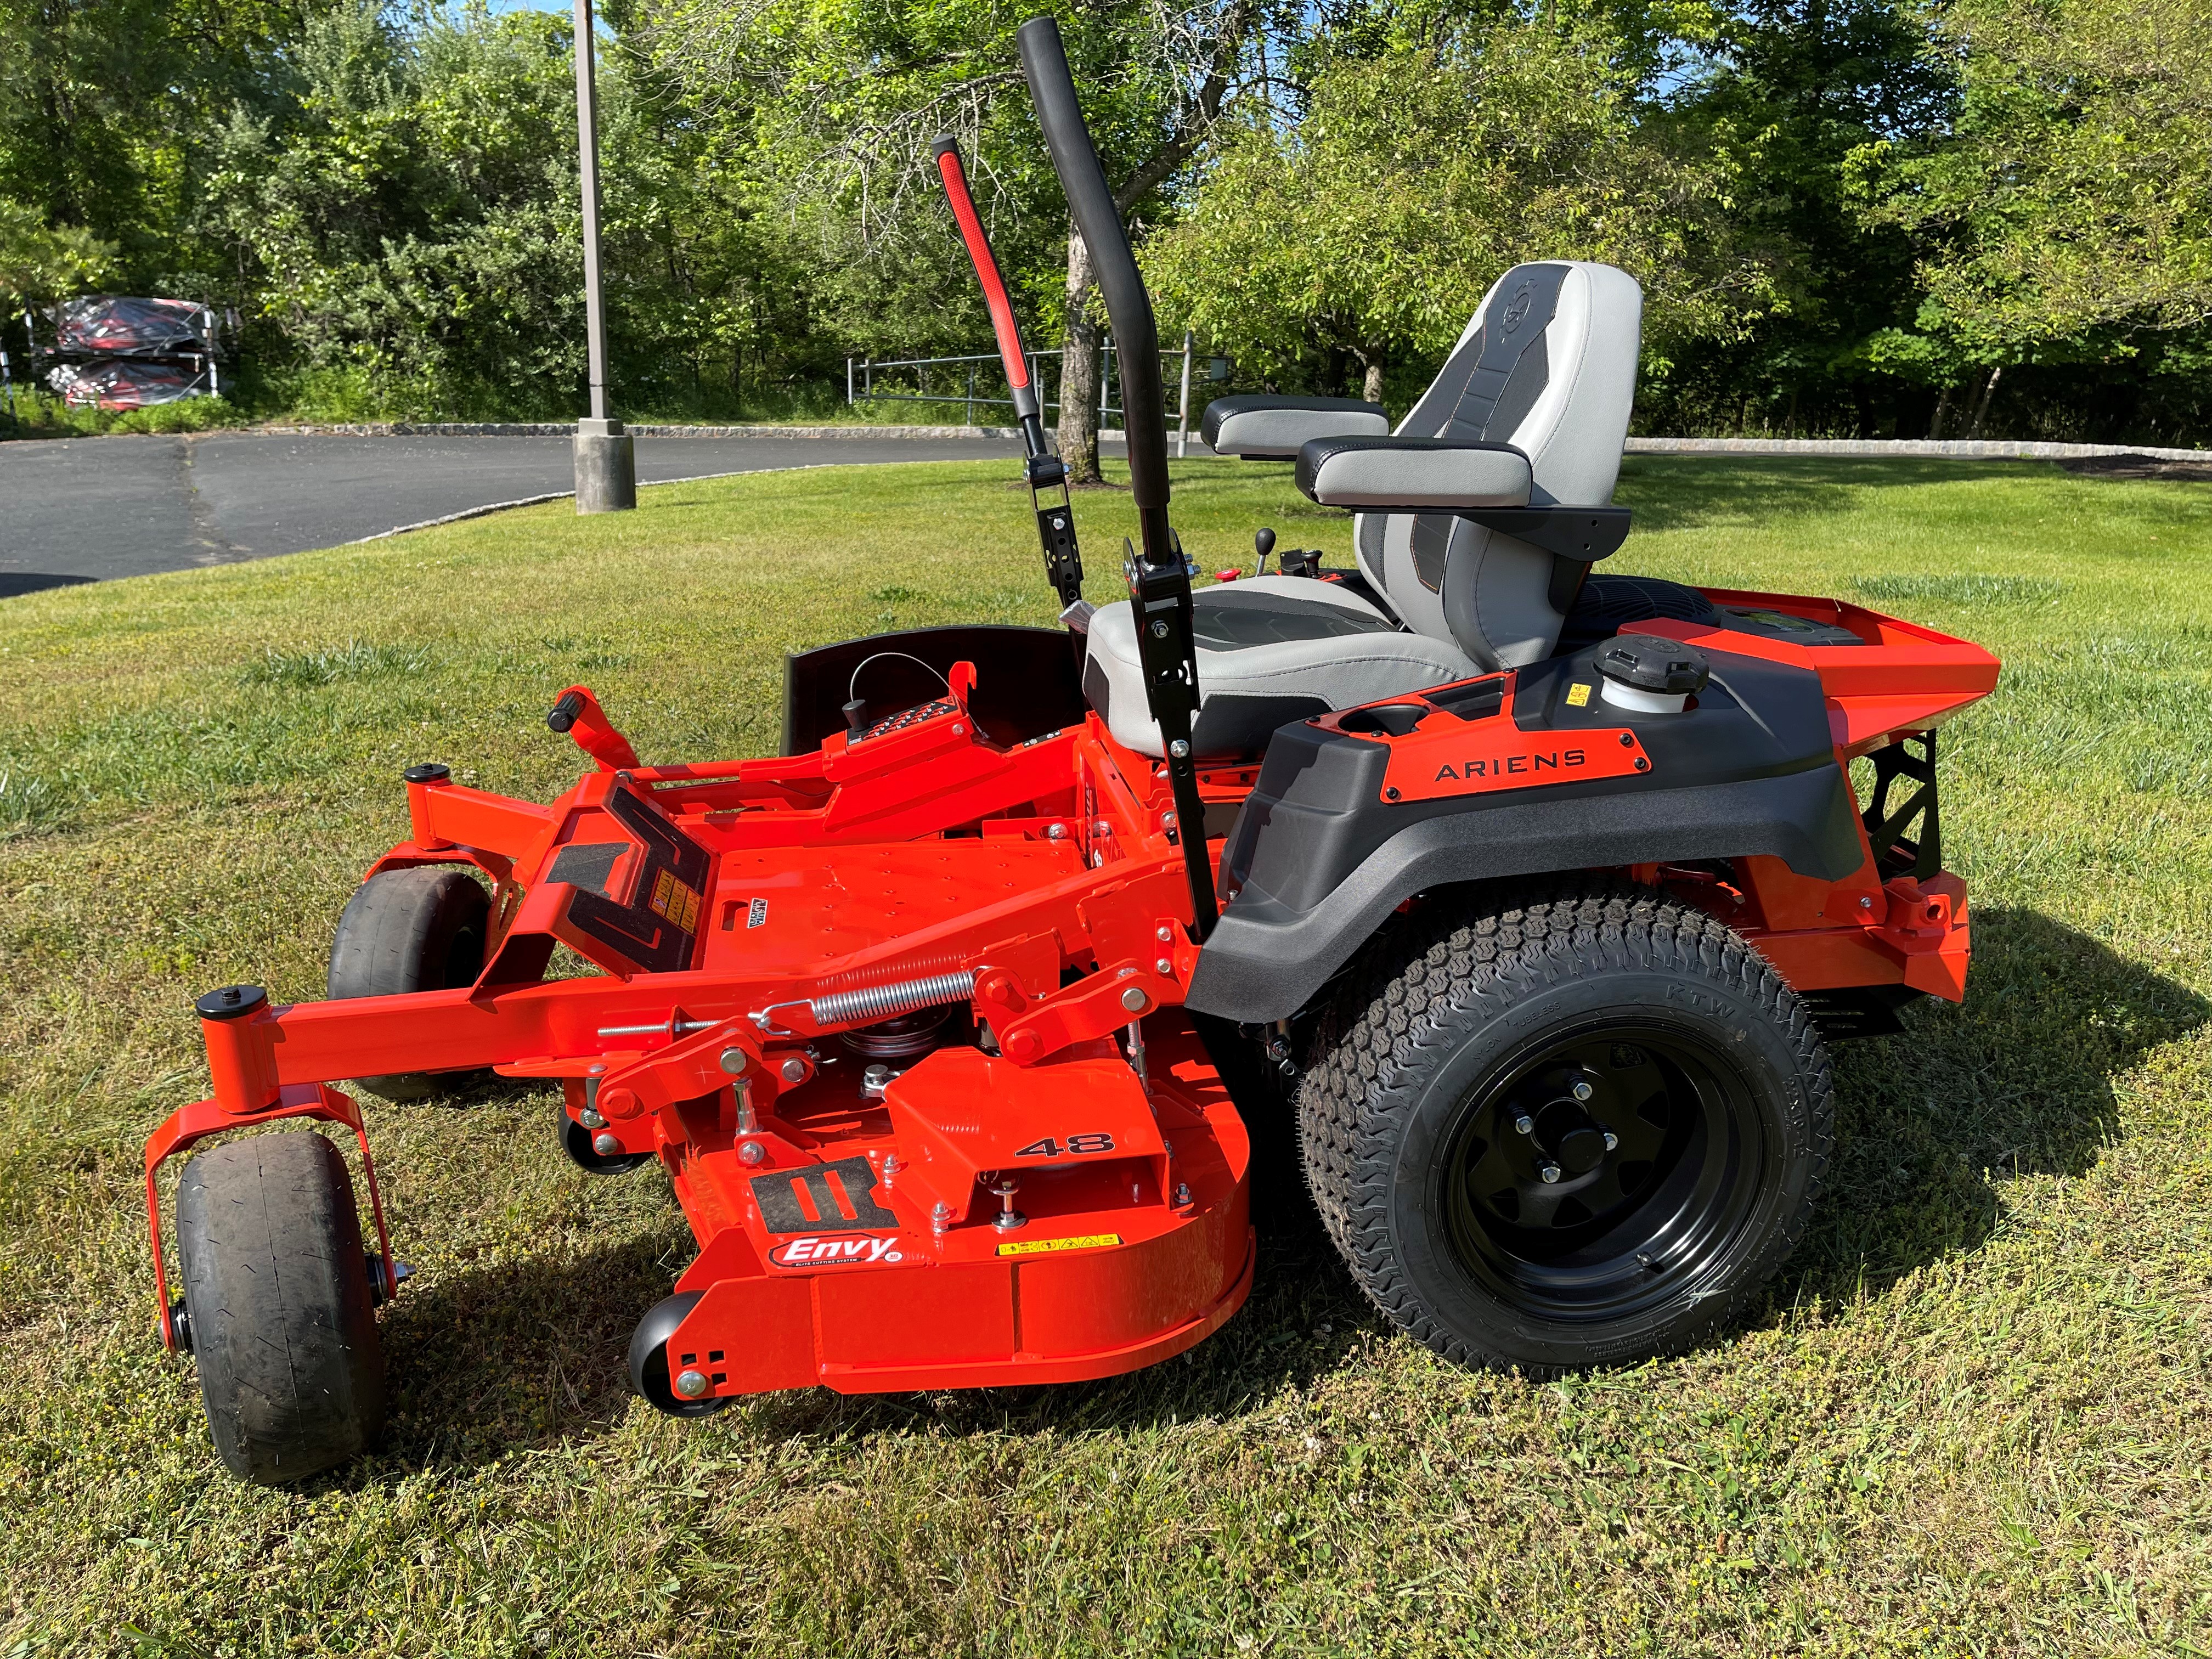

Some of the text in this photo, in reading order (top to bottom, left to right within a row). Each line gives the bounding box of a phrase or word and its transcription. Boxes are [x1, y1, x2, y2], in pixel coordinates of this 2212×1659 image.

[1435, 749, 1586, 783] ARIENS
[1666, 984, 1736, 1019] KTW
[1471, 1001, 1561, 1063] NYLON TUBELESS
[1014, 1132, 1116, 1158] 48
[782, 1237, 899, 1262] Envy
